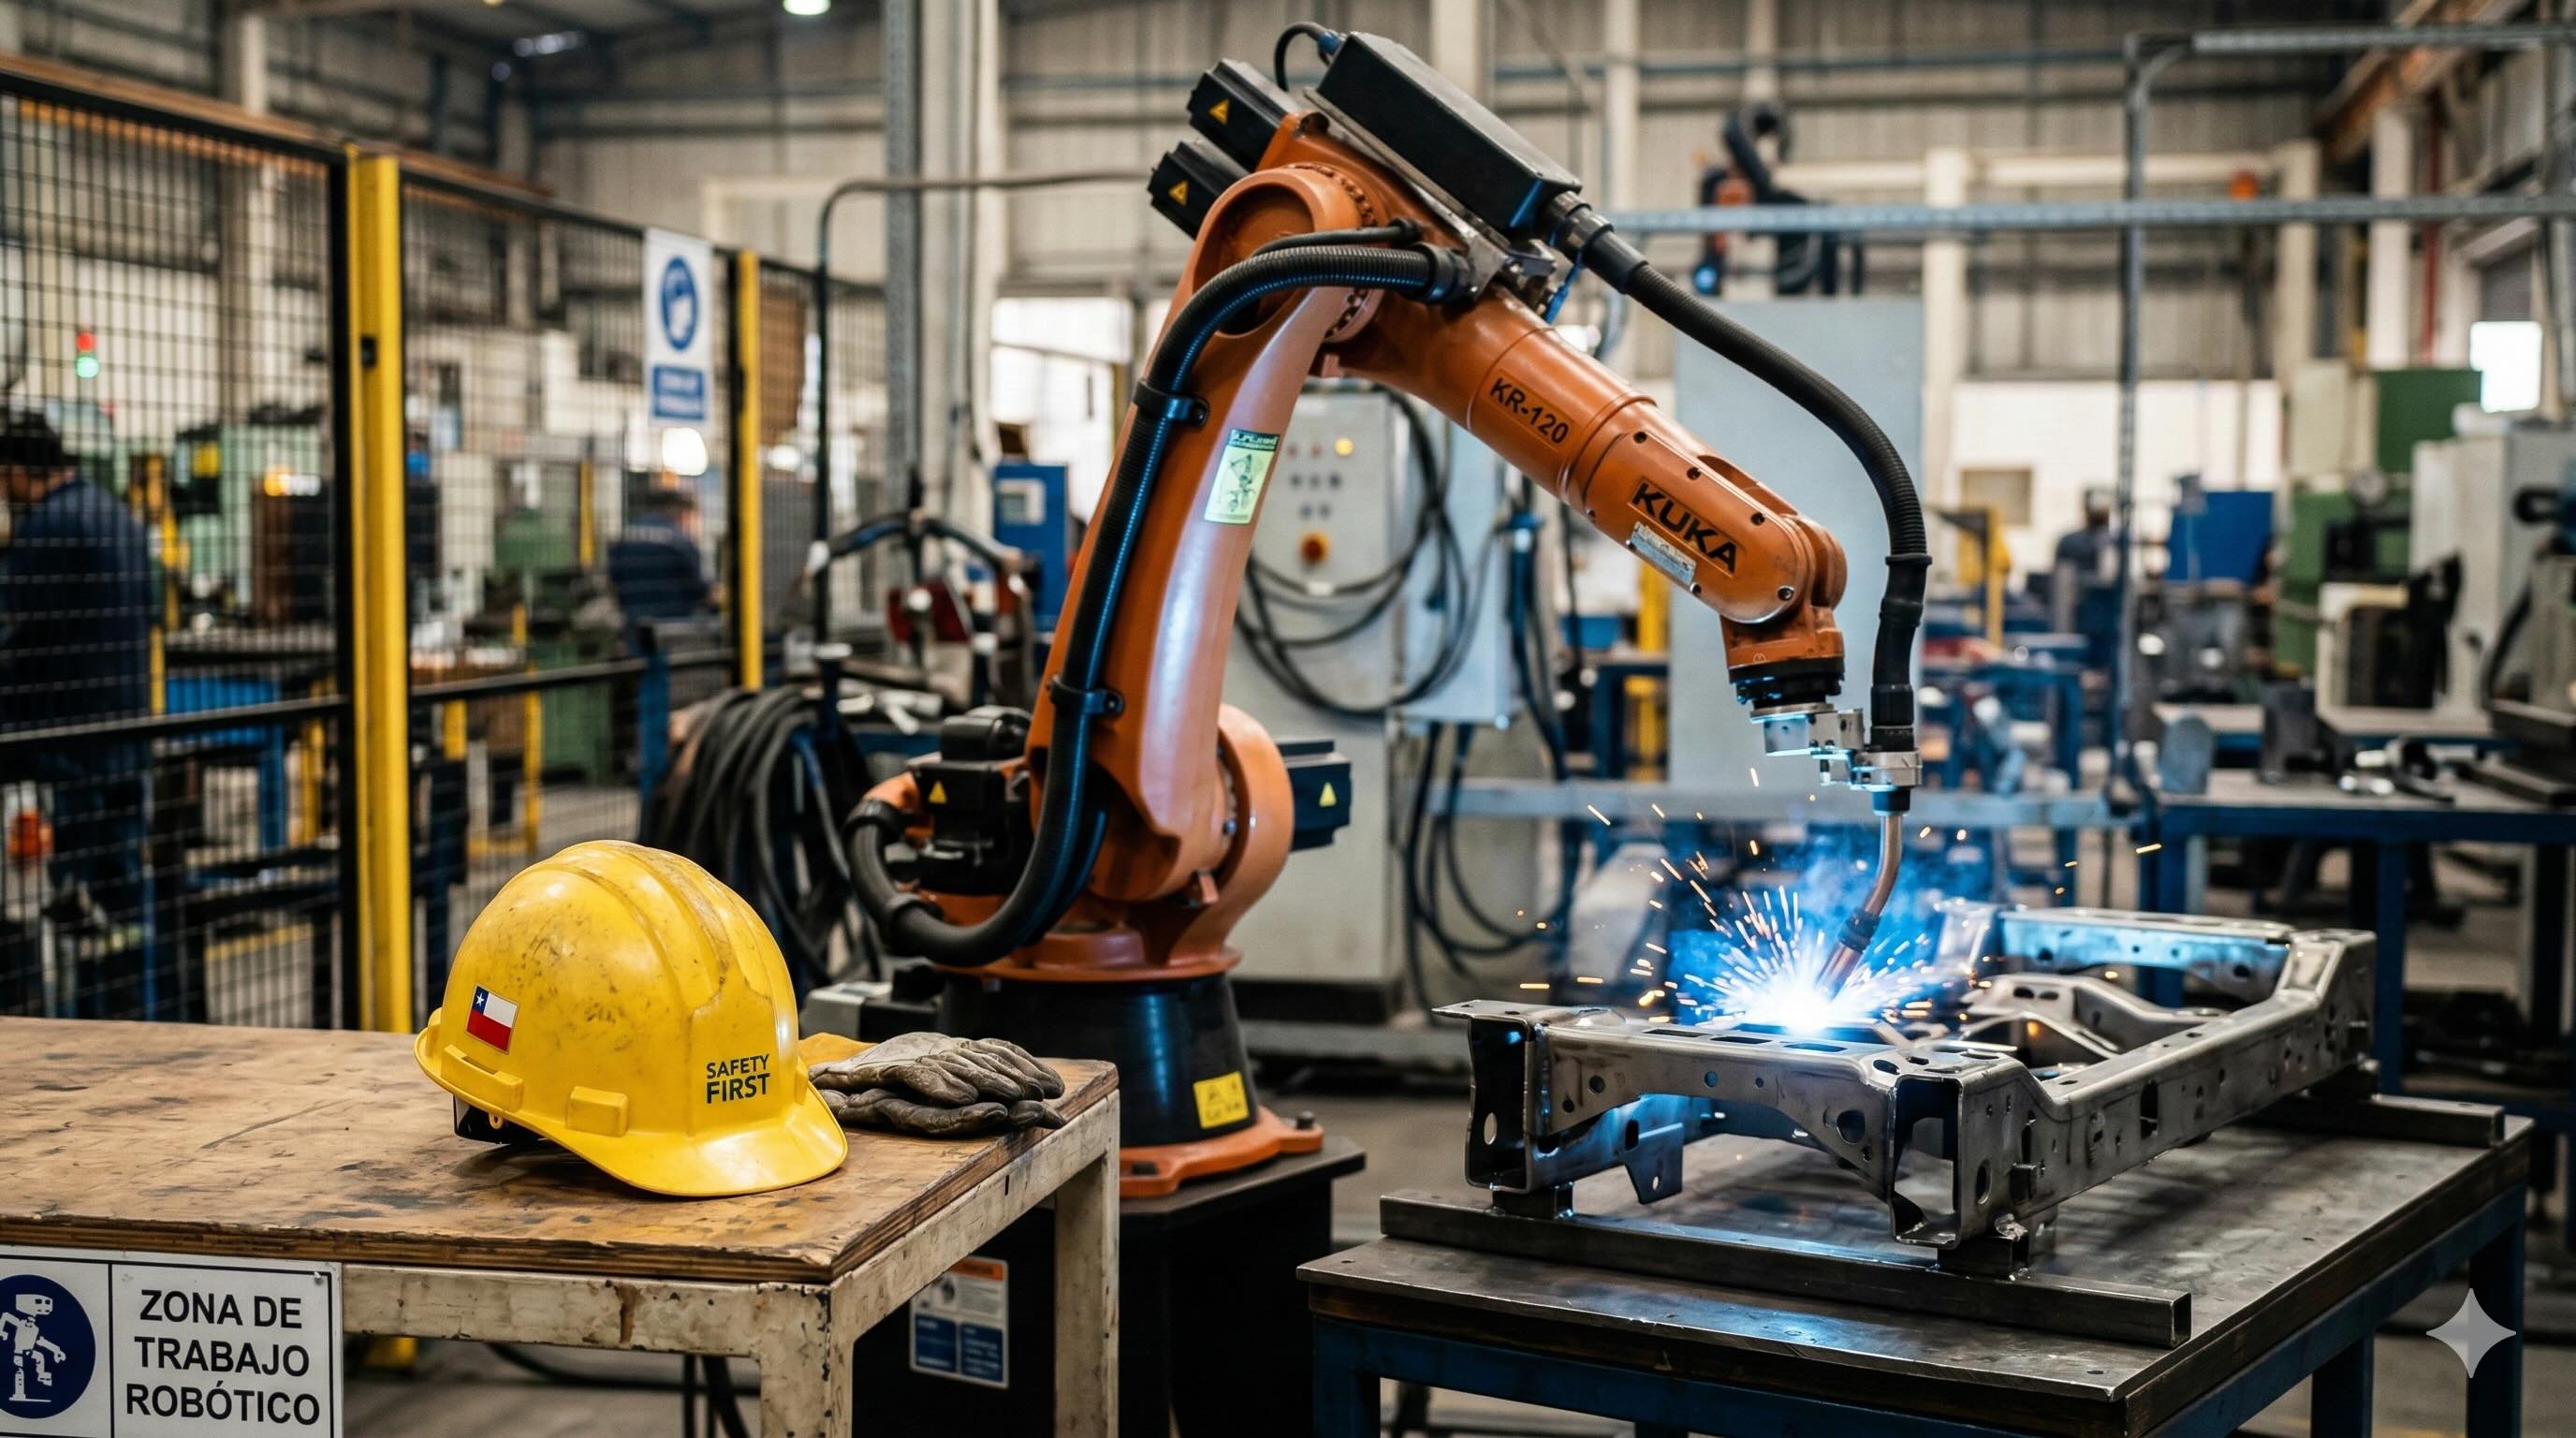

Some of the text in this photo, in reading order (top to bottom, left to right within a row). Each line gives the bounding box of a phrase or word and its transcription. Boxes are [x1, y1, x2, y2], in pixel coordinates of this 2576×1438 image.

[1490, 377, 1569, 444] KR-120
[1632, 482, 1736, 573] KUKA
[706, 1053, 769, 1079] SAFETY
[707, 1073, 770, 1104] FIRST
[139, 1289, 302, 1328] ZONA DE
[134, 1336, 310, 1377] TRABAJO
[126, 1380, 320, 1426] ROBÓTICO
